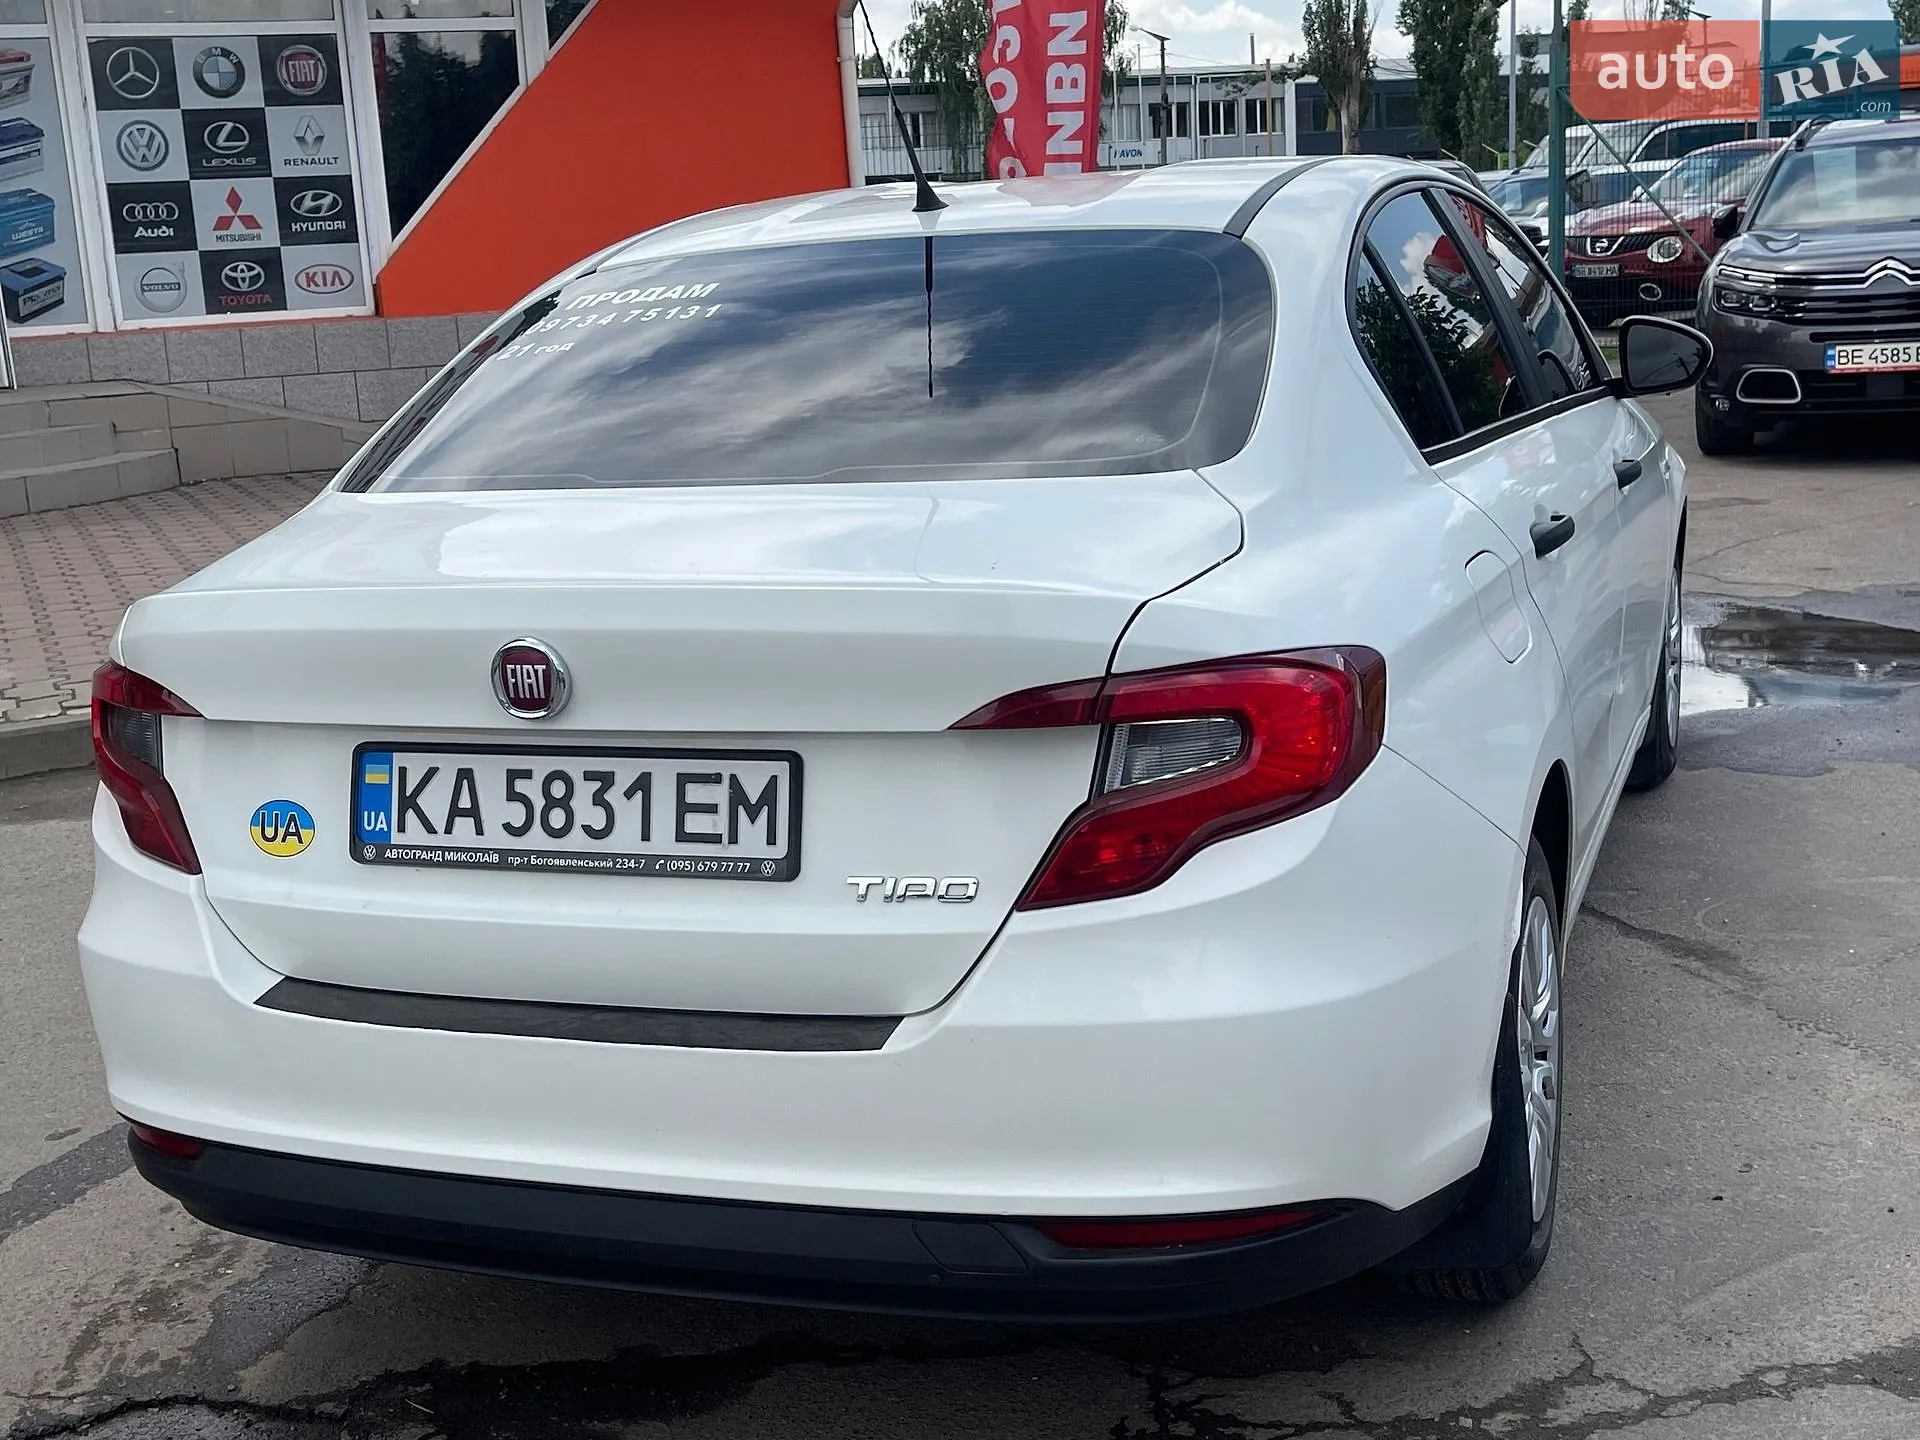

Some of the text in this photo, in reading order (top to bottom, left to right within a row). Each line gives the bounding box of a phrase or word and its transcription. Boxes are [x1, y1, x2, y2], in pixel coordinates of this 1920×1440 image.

[287, 59, 318, 82] FIAT
[202, 156, 257, 168] LEXUS
[283, 156, 340, 168] RENAULT
[133, 226, 175, 239] Audi
[291, 220, 347, 232] HYUNDAI
[215, 232, 262, 243] MITSUBISHI
[142, 282, 180, 292] VOLVO
[304, 270, 346, 289] KIA
[219, 294, 273, 307] TOYOTA
[565, 282, 720, 311] ПРОДАМ
[1837, 348, 1864, 366] BE
[1868, 346, 1912, 364] 4585
[505, 664, 547, 700] FIAT
[396, 765, 778, 846] KA 5831 EM
[259, 811, 305, 846] UA
[362, 810, 388, 833] UA
[384, 848, 751, 874] АВТОГРАНД МИКОЛАЇВ пр-т Богоявленський 234-7 (095) 679 77 77
[845, 875, 981, 904] TIPO
